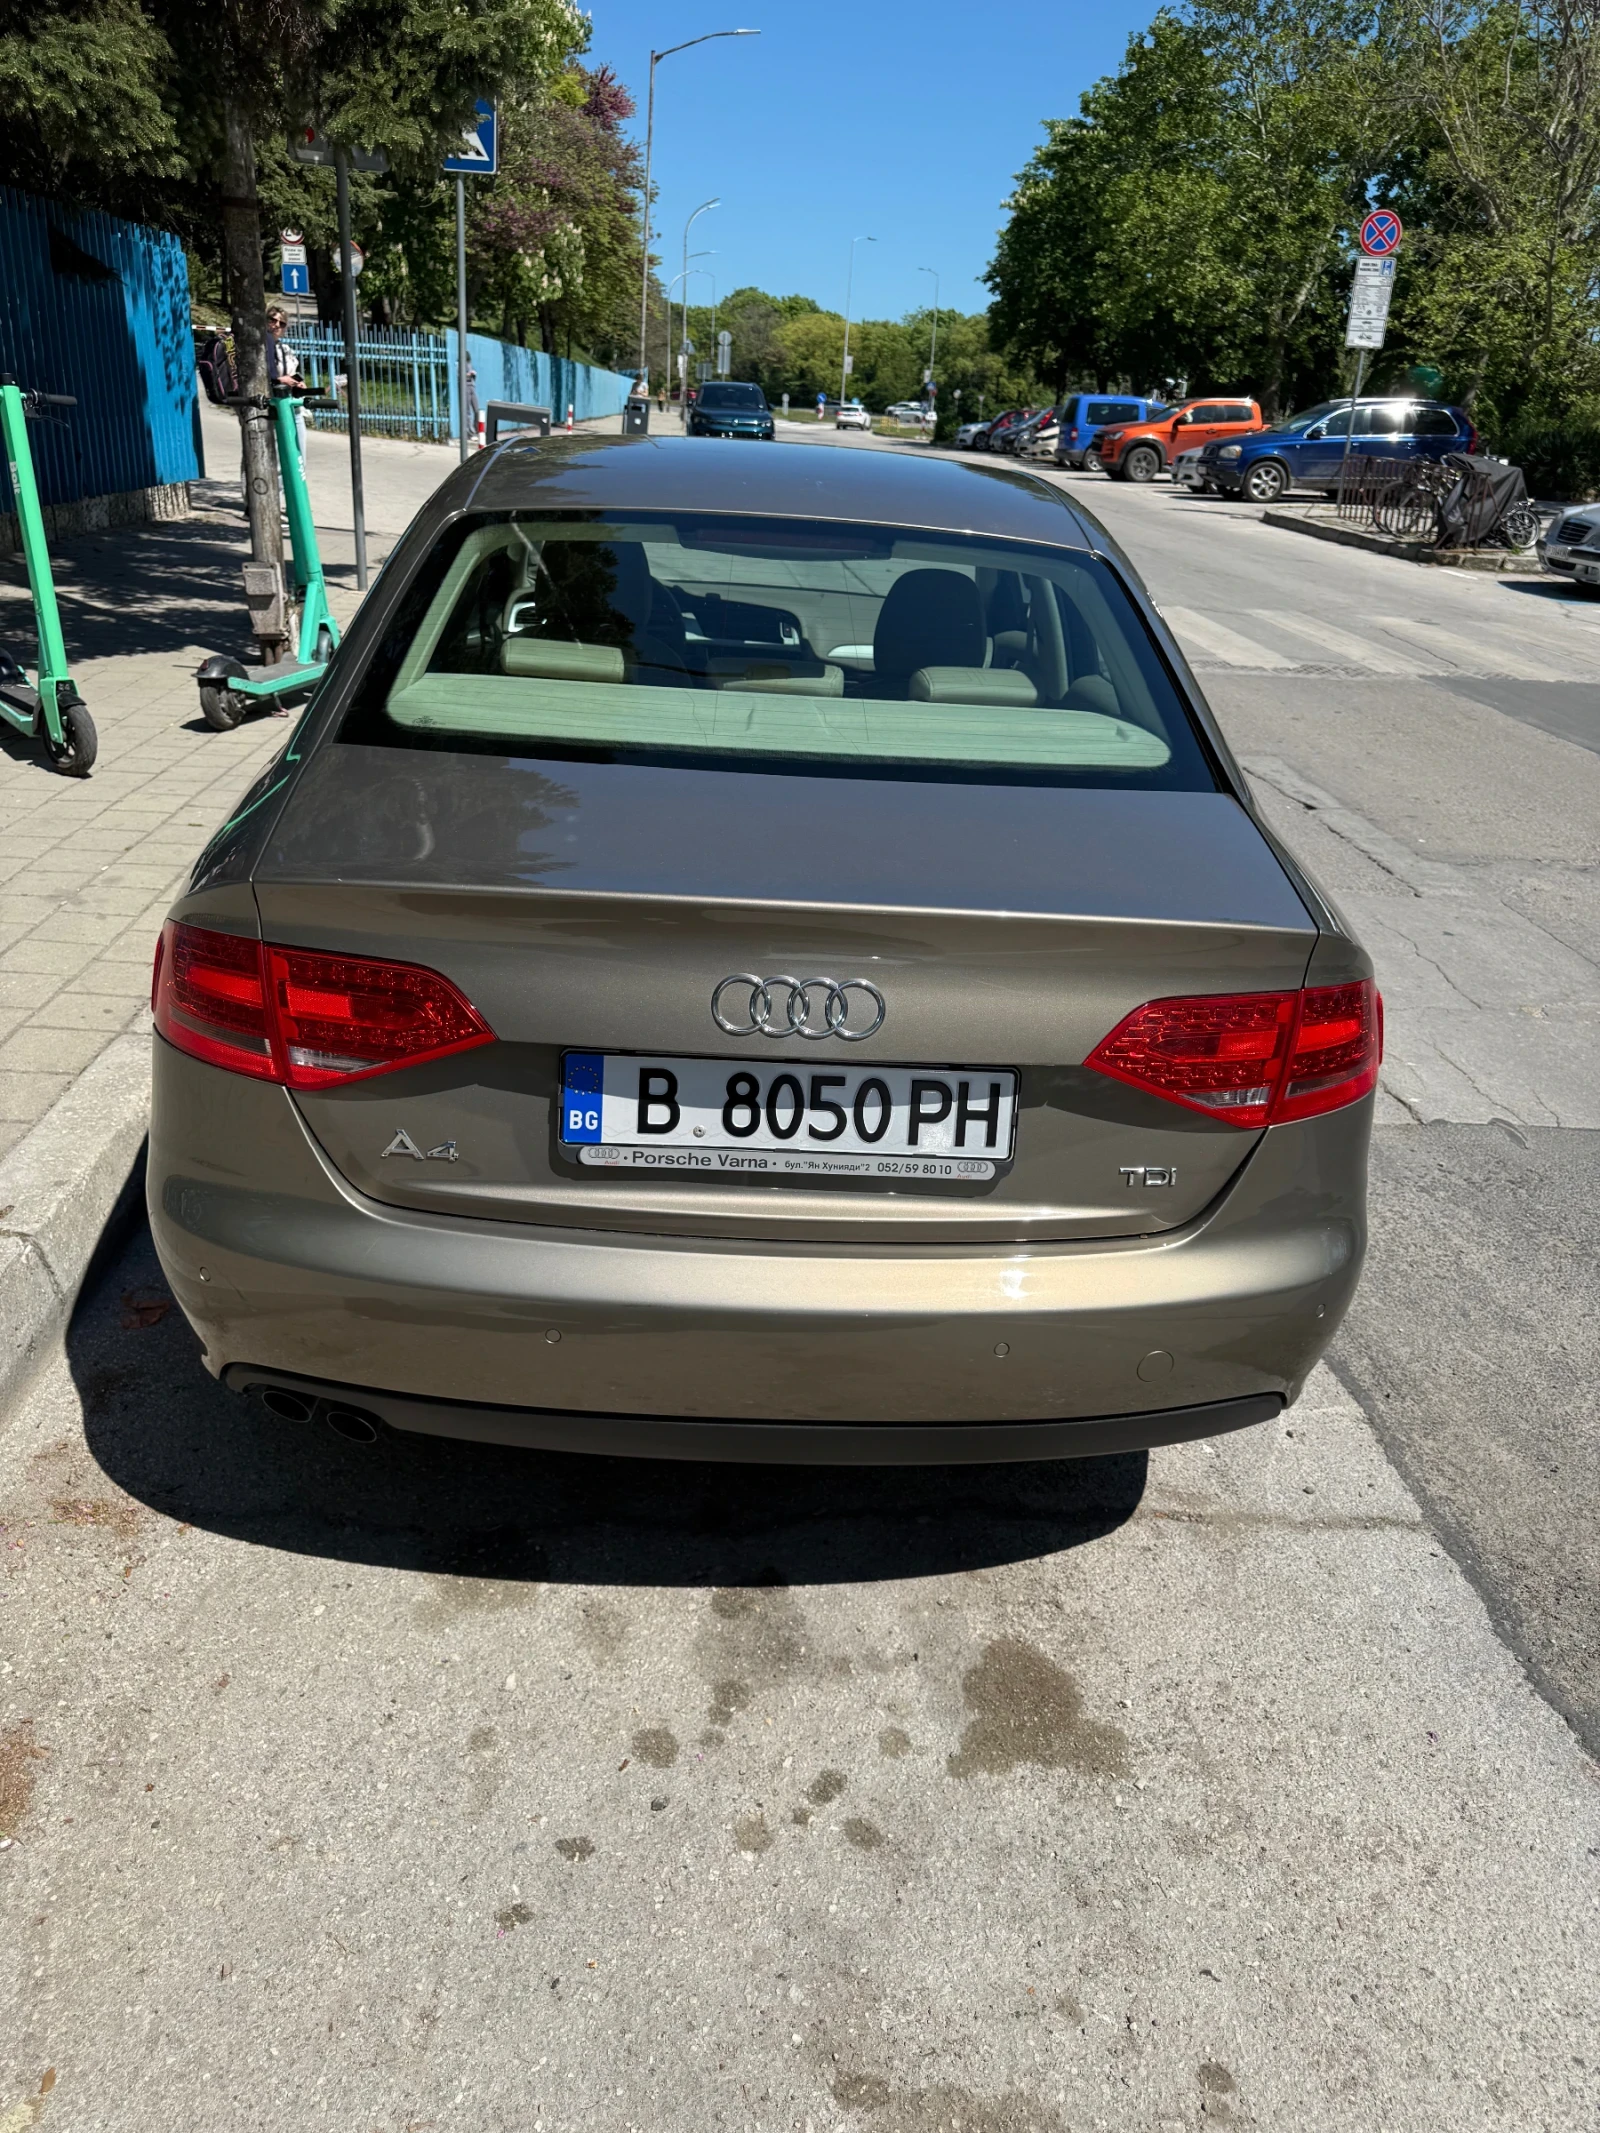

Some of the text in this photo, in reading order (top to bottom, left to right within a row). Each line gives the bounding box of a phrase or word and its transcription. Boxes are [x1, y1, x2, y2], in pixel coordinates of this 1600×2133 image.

[9, 461, 21, 494] Bolt
[569, 1109, 598, 1130] BG
[637, 1067, 1001, 1147] B 8050 PH
[381, 1128, 459, 1161] A4
[632, 1150, 712, 1166] Porsche
[717, 1153, 768, 1169] Varna
[877, 1162, 919, 1174] 052/59
[1119, 1167, 1177, 1186] TDI
